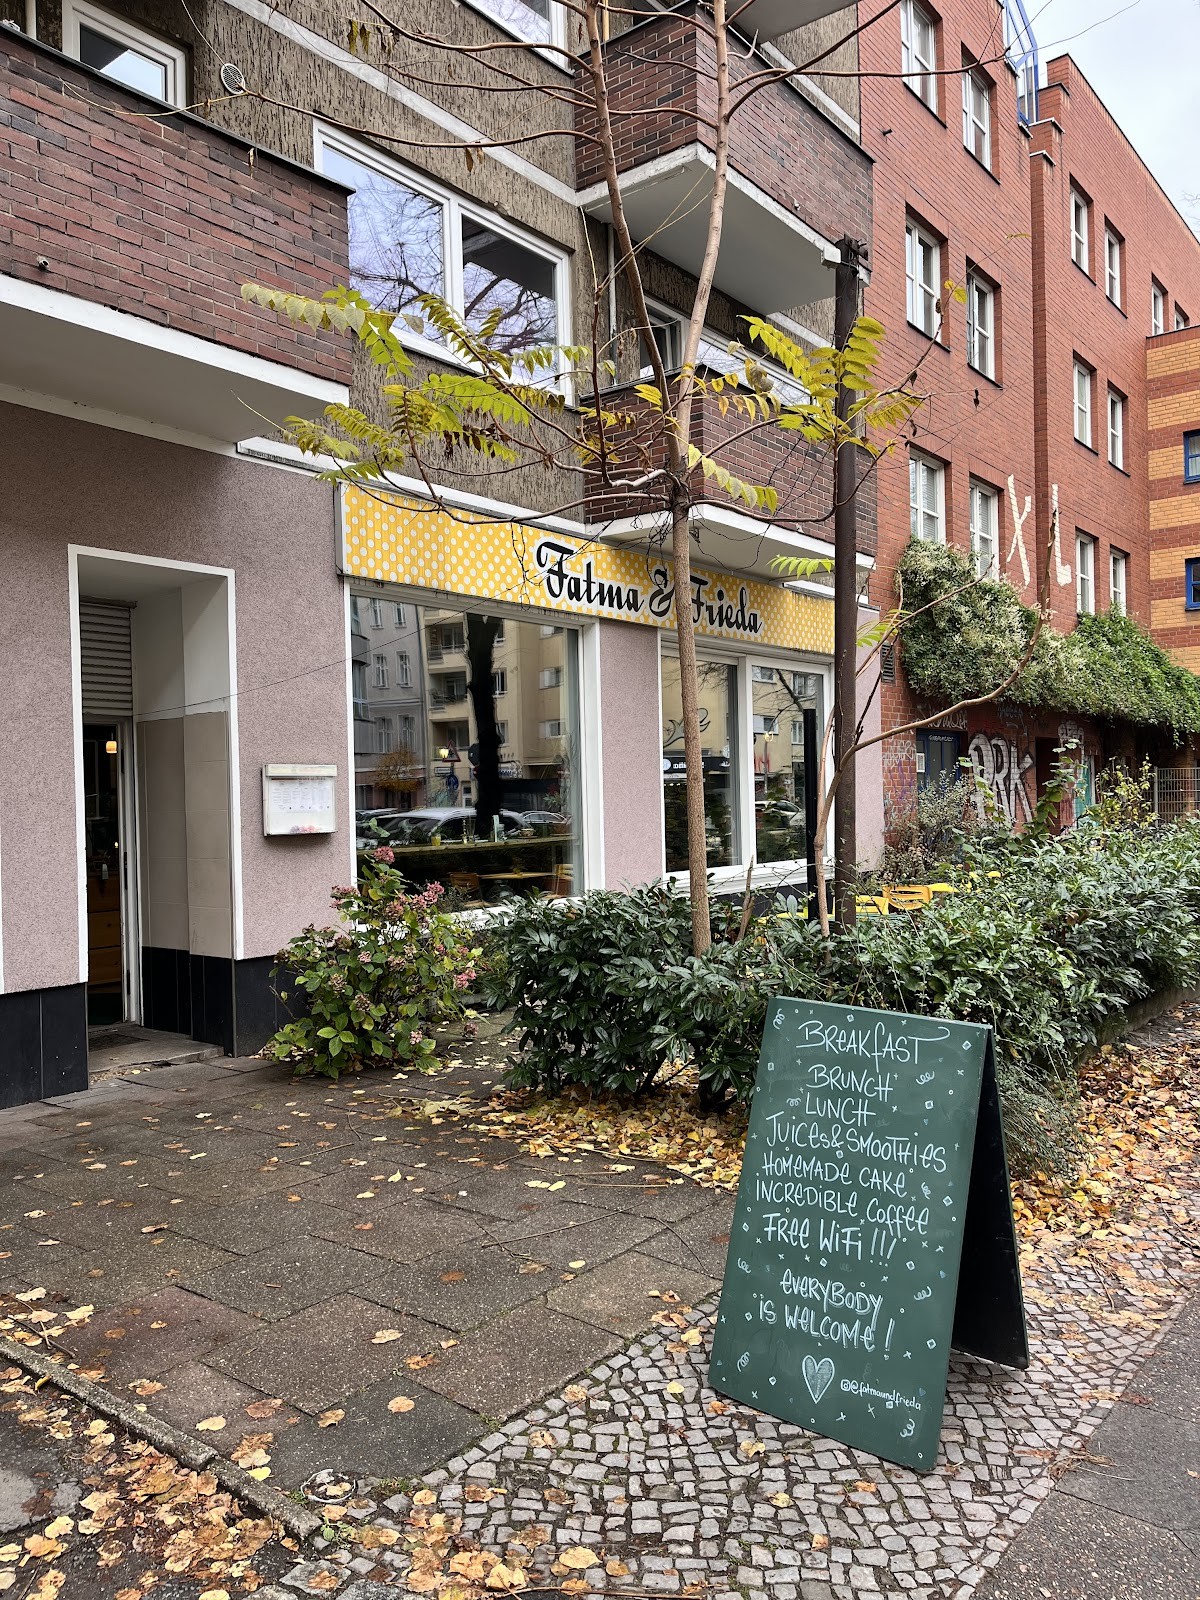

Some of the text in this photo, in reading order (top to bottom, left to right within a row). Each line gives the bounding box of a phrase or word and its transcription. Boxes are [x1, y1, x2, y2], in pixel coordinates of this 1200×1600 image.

[536, 541, 763, 634] Fatma & Frieda
[806, 1064, 893, 1102] BRUNCH
[805, 1092, 876, 1127] LUNCH
